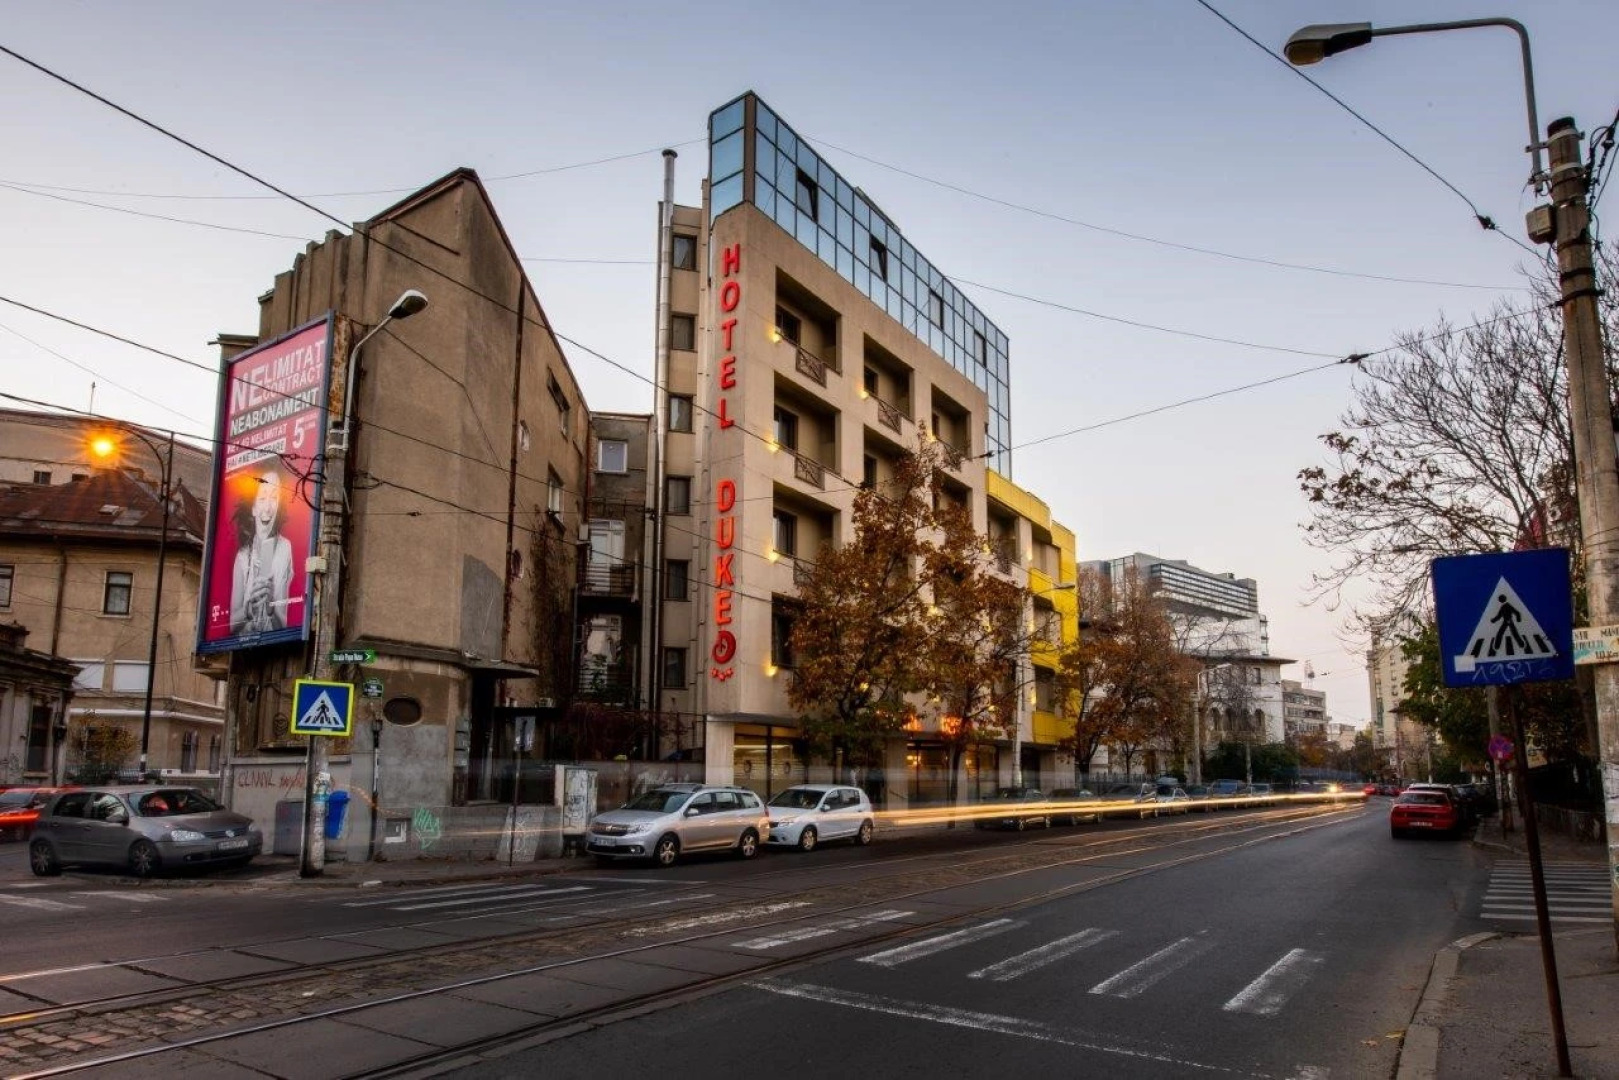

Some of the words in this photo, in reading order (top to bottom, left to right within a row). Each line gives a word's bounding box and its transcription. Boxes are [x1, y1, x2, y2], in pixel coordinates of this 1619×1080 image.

[718, 244, 741, 429] HOTEL
[263, 363, 322, 400] CONTRACT
[264, 339, 325, 384] LIMITAT
[231, 367, 265, 414] NE
[231, 387, 319, 436] NEABONAMENT
[292, 417, 305, 448] 5
[714, 480, 737, 625] DUKE
